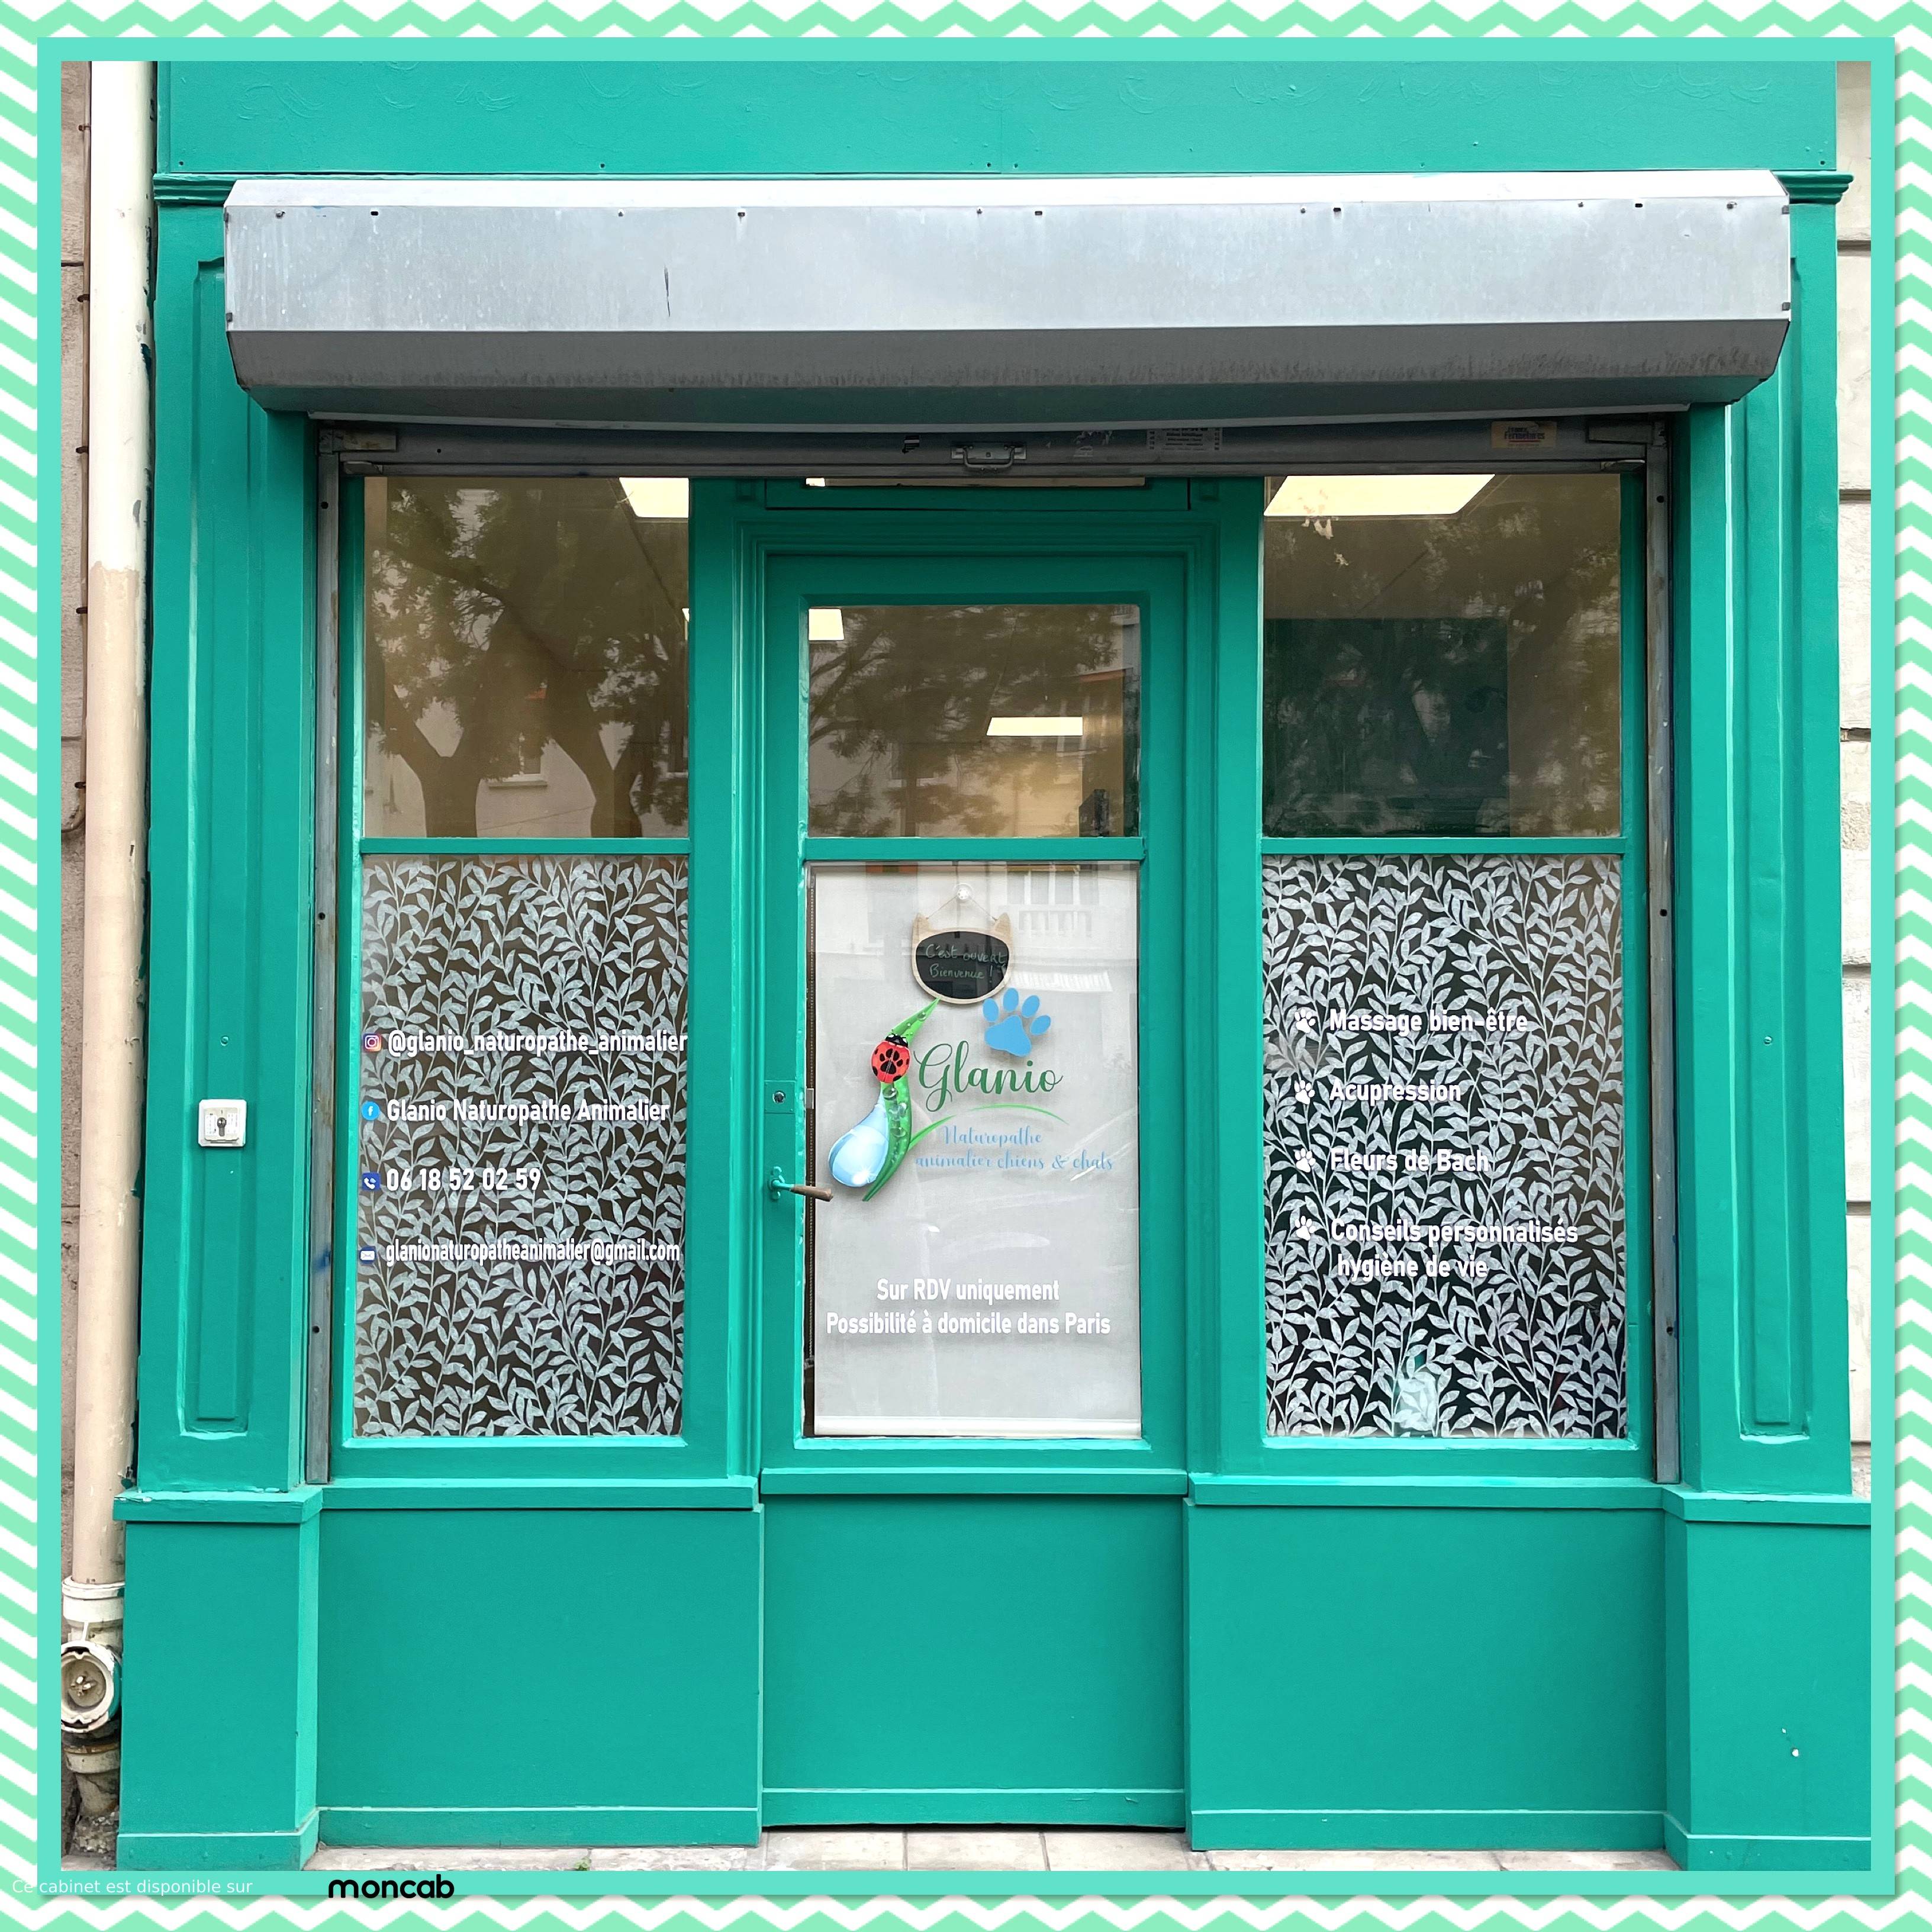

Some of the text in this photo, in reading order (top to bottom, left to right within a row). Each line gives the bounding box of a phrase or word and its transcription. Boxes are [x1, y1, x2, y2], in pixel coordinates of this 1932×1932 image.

[930, 963, 985, 978] Bienvenue
[1329, 1007, 1528, 1036] Massage bien-être
[388, 1029, 688, 1057] @glanio_naturopathe_animalier
[914, 1041, 1064, 1112] Glanio
[1329, 1079, 1461, 1106] Acupression
[387, 1100, 670, 1126] Glanio Naturopathe Animalier
[942, 1126, 1042, 1148] Naturopathe
[915, 1151, 1113, 1171] animalier chiens & chats
[1329, 1148, 1489, 1173] Fleurs de Bach
[387, 1168, 541, 1191] 06 18 52 02 59
[1331, 1219, 1578, 1247] Conseils personnalisés
[386, 1238, 681, 1267] glanionaturopatheanimalier@gmail.com
[1338, 1252, 1487, 1281] hygiène de vie
[877, 1278, 1060, 1305] Sur RDV uniquement
[826, 1309, 1111, 1334] Possibilité à domicile dans Paris
